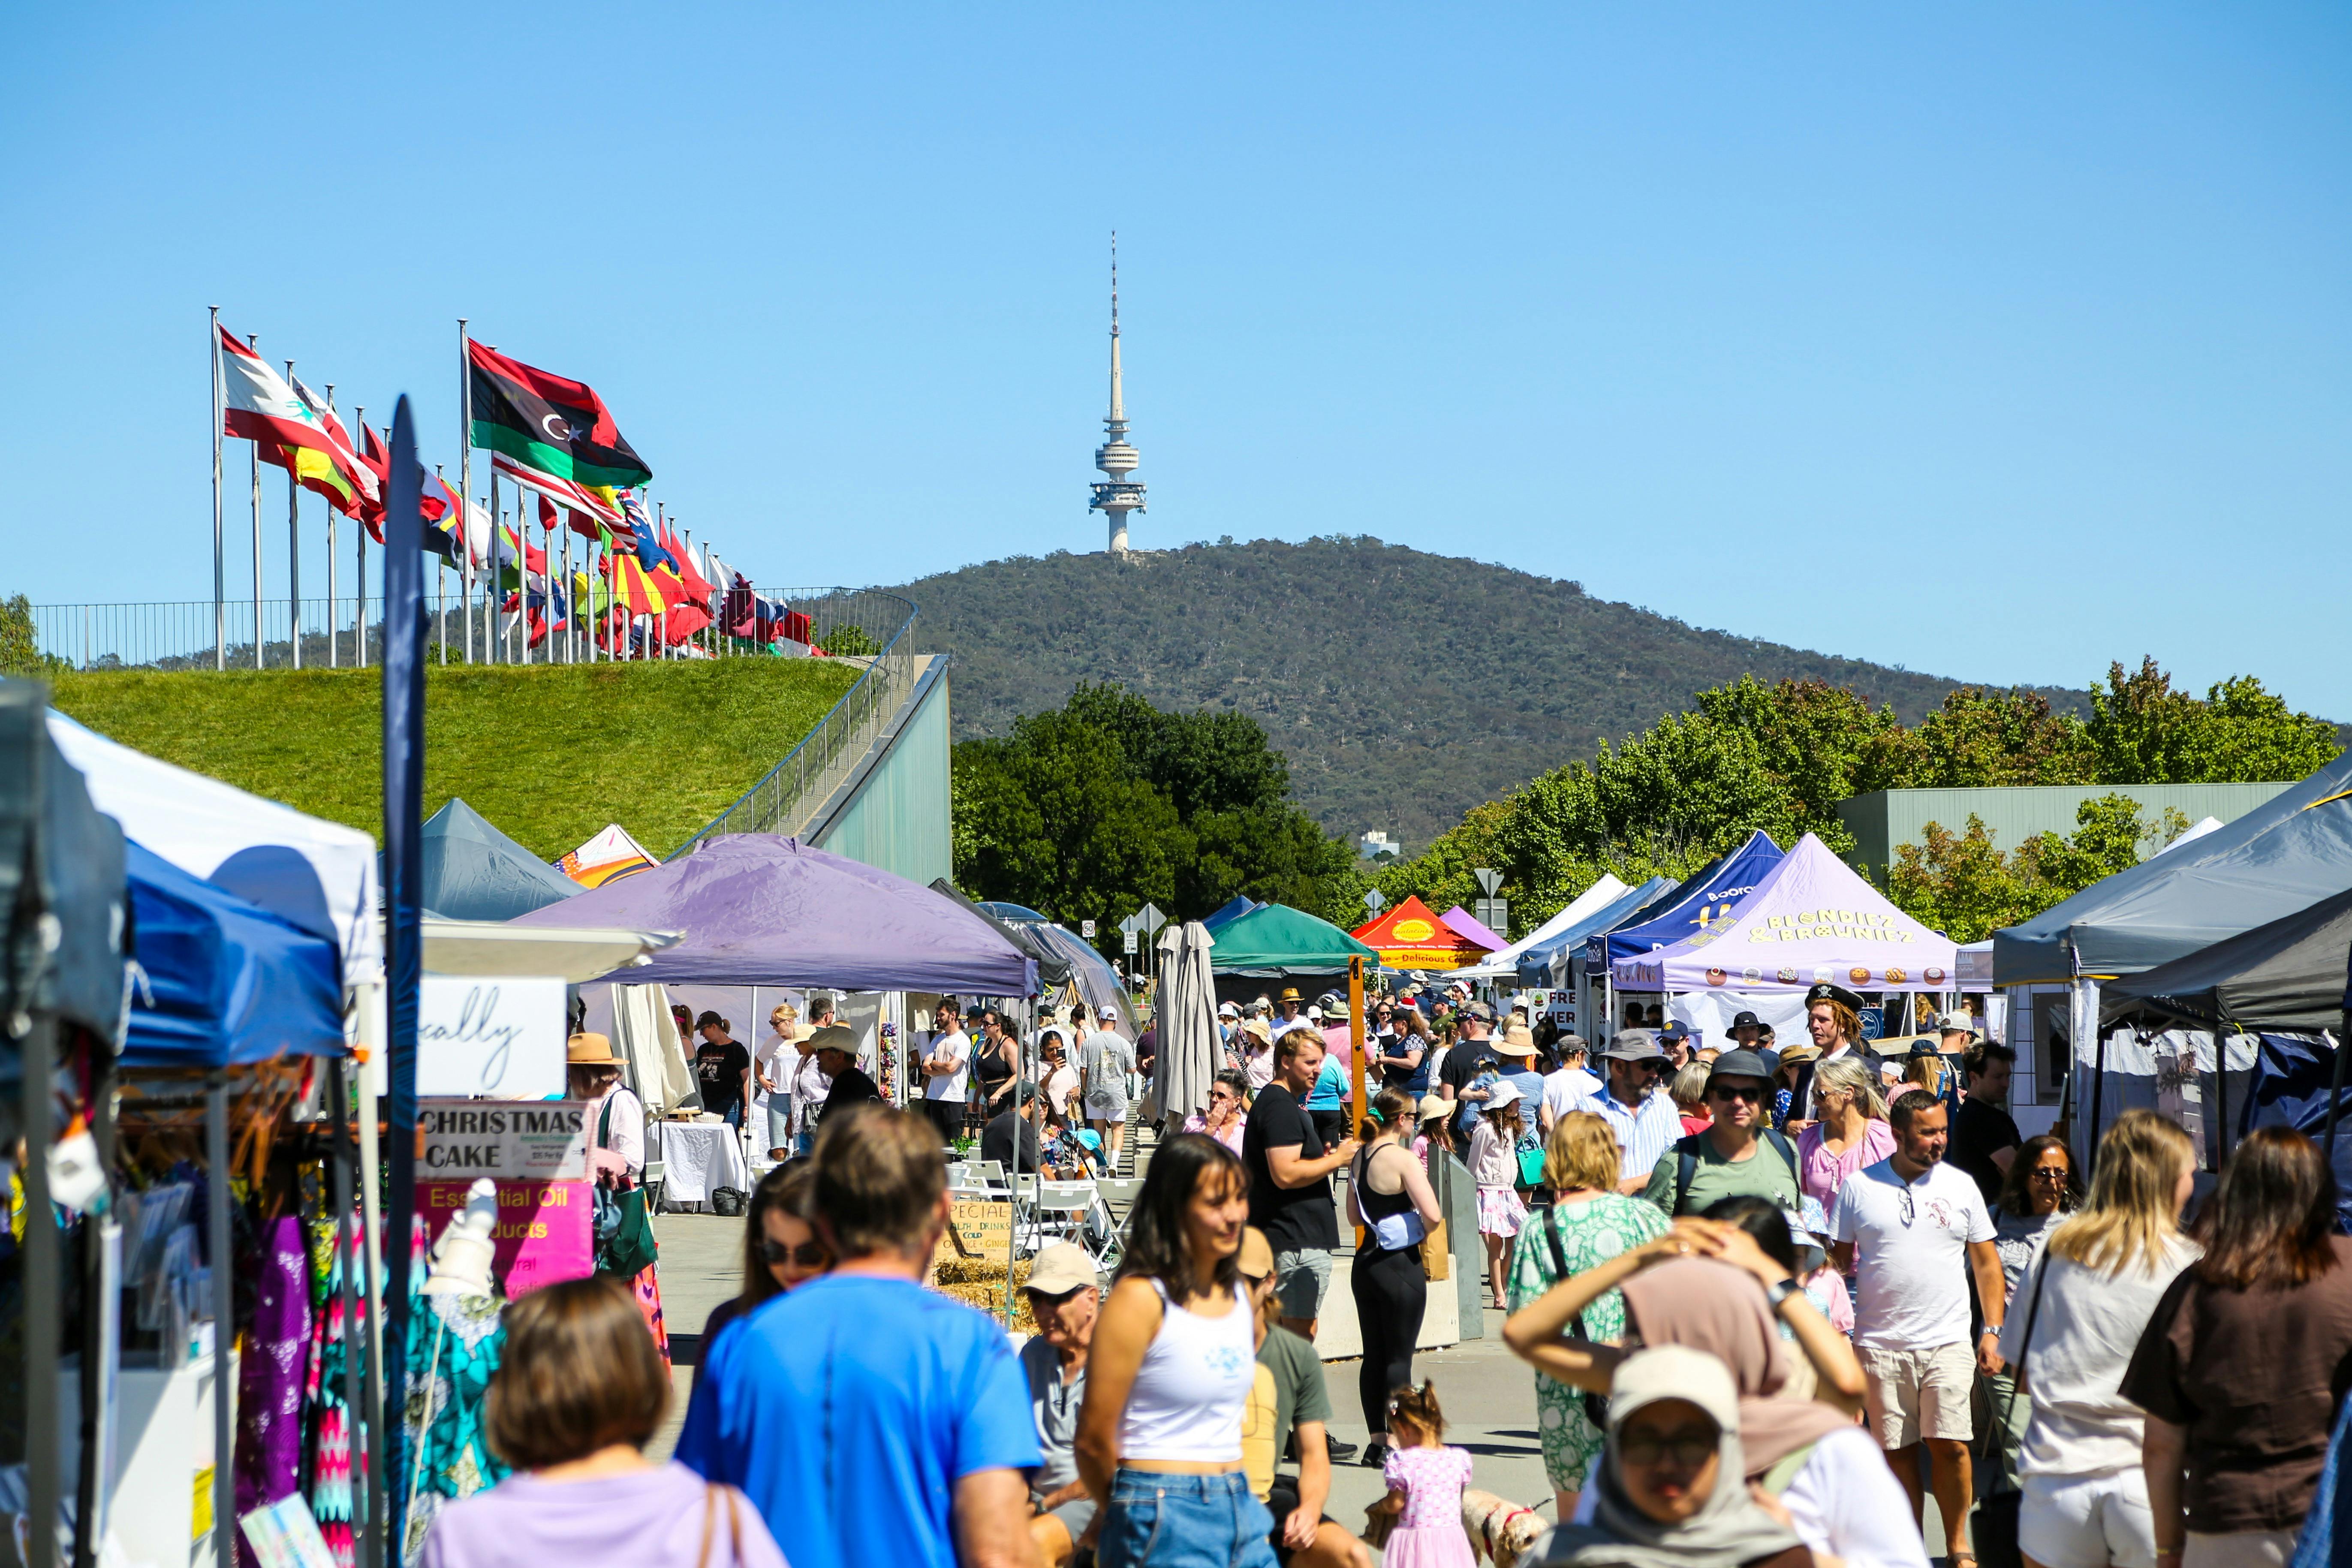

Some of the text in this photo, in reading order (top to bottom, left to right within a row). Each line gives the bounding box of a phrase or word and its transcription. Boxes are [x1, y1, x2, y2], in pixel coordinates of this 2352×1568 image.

[1768, 909, 1897, 929] BLONDIEZ
[1748, 925, 1917, 943] & BROWNIEZ
[1402, 954, 1445, 962] Delicious
[417, 1111, 583, 1134] CHRISTMAS
[426, 1145, 501, 1168] CAKE
[431, 1187, 568, 1207] Esstial Oil
[949, 1205, 1006, 1218] PECIAL
[489, 1220, 548, 1239] ducts
[980, 1222, 1010, 1231] DRINKS
